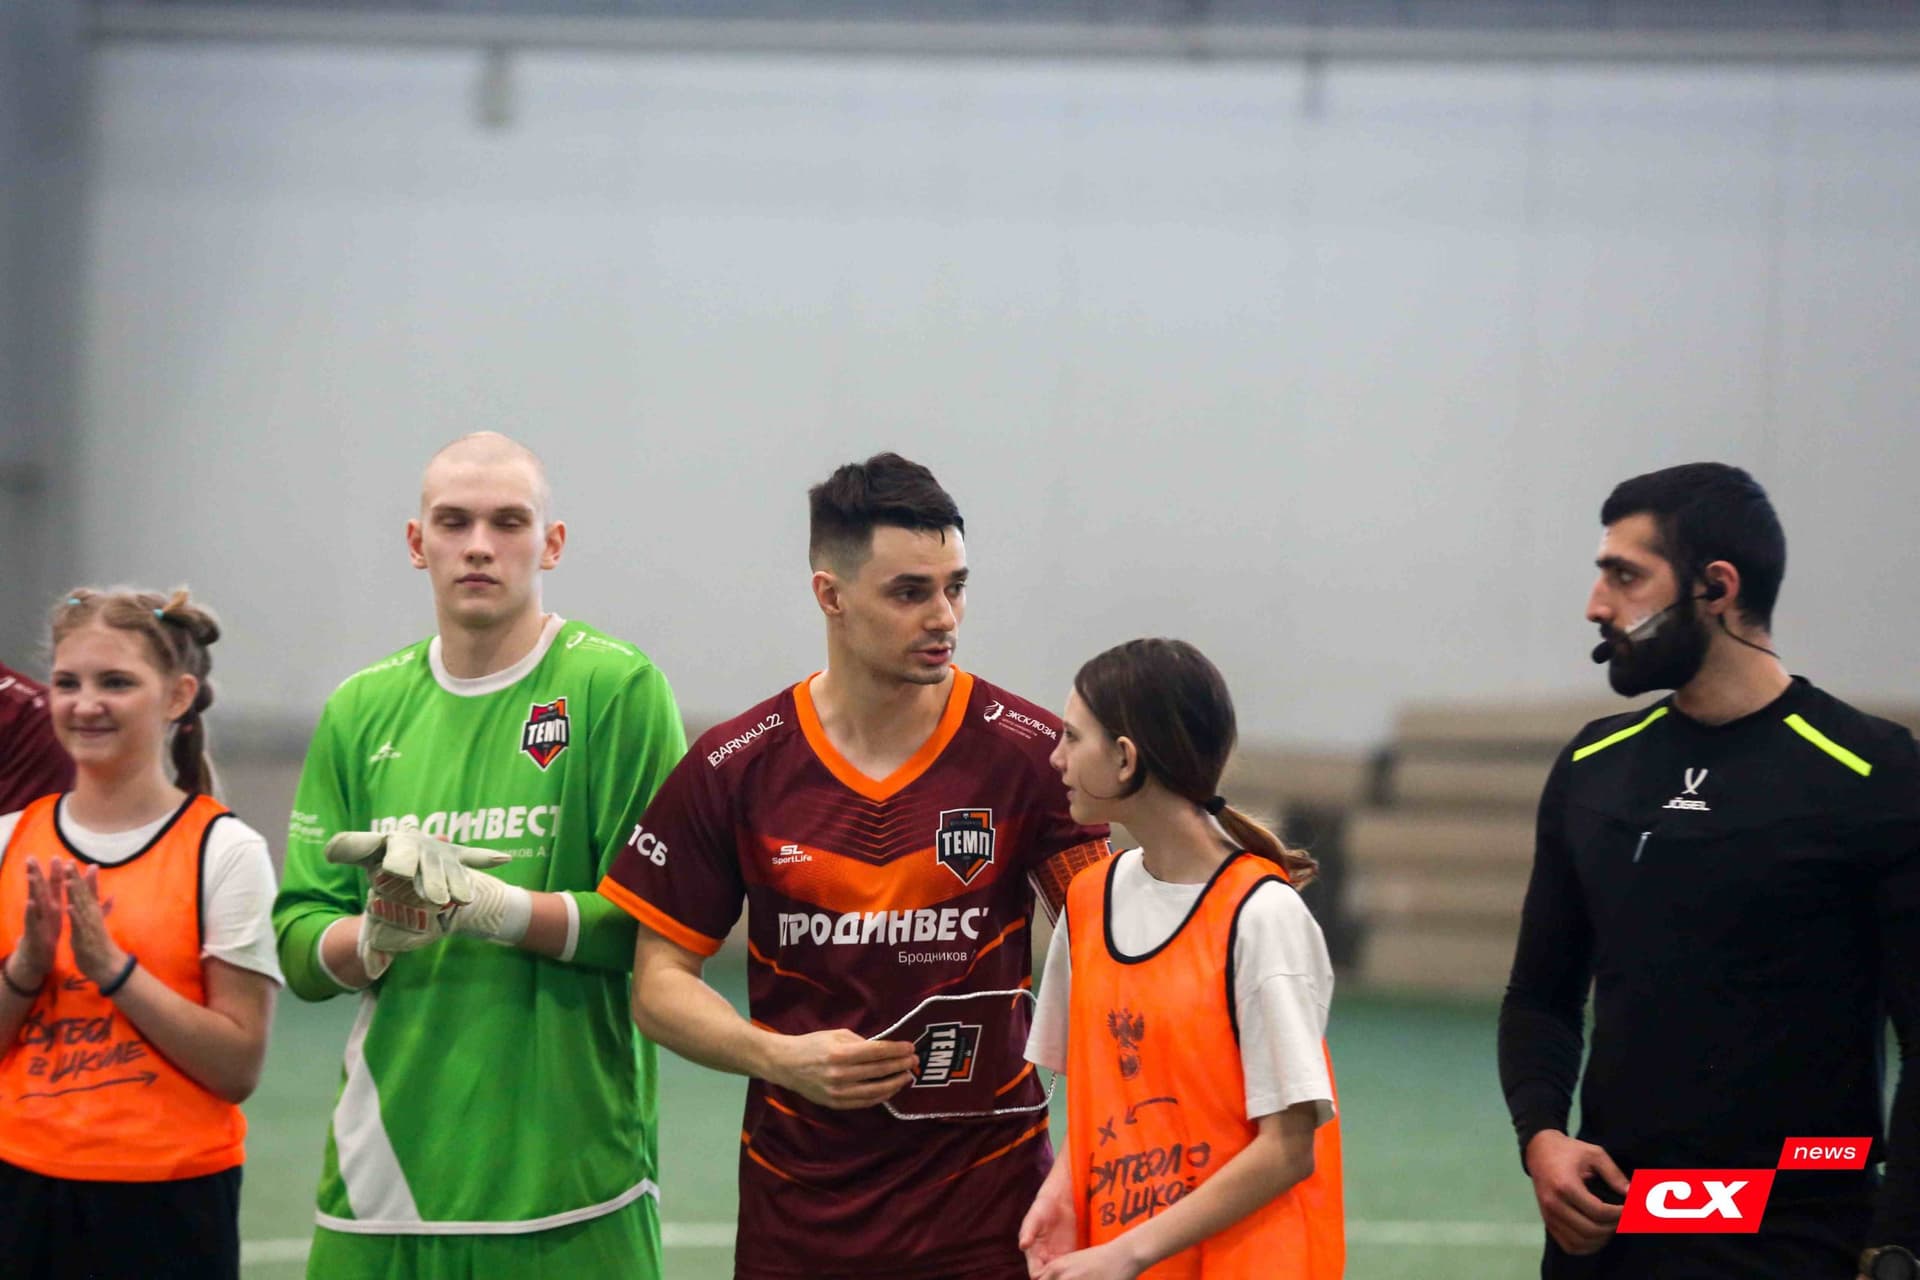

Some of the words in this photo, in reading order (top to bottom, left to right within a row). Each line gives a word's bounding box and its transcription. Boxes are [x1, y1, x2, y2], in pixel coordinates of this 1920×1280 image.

[527, 718, 567, 746] ТЕМП
[942, 830, 990, 856] ТЕМП
[771, 855, 813, 865] SportLife
[898, 951, 968, 966] Бродников
[921, 1028, 957, 1081] ТЕМП
